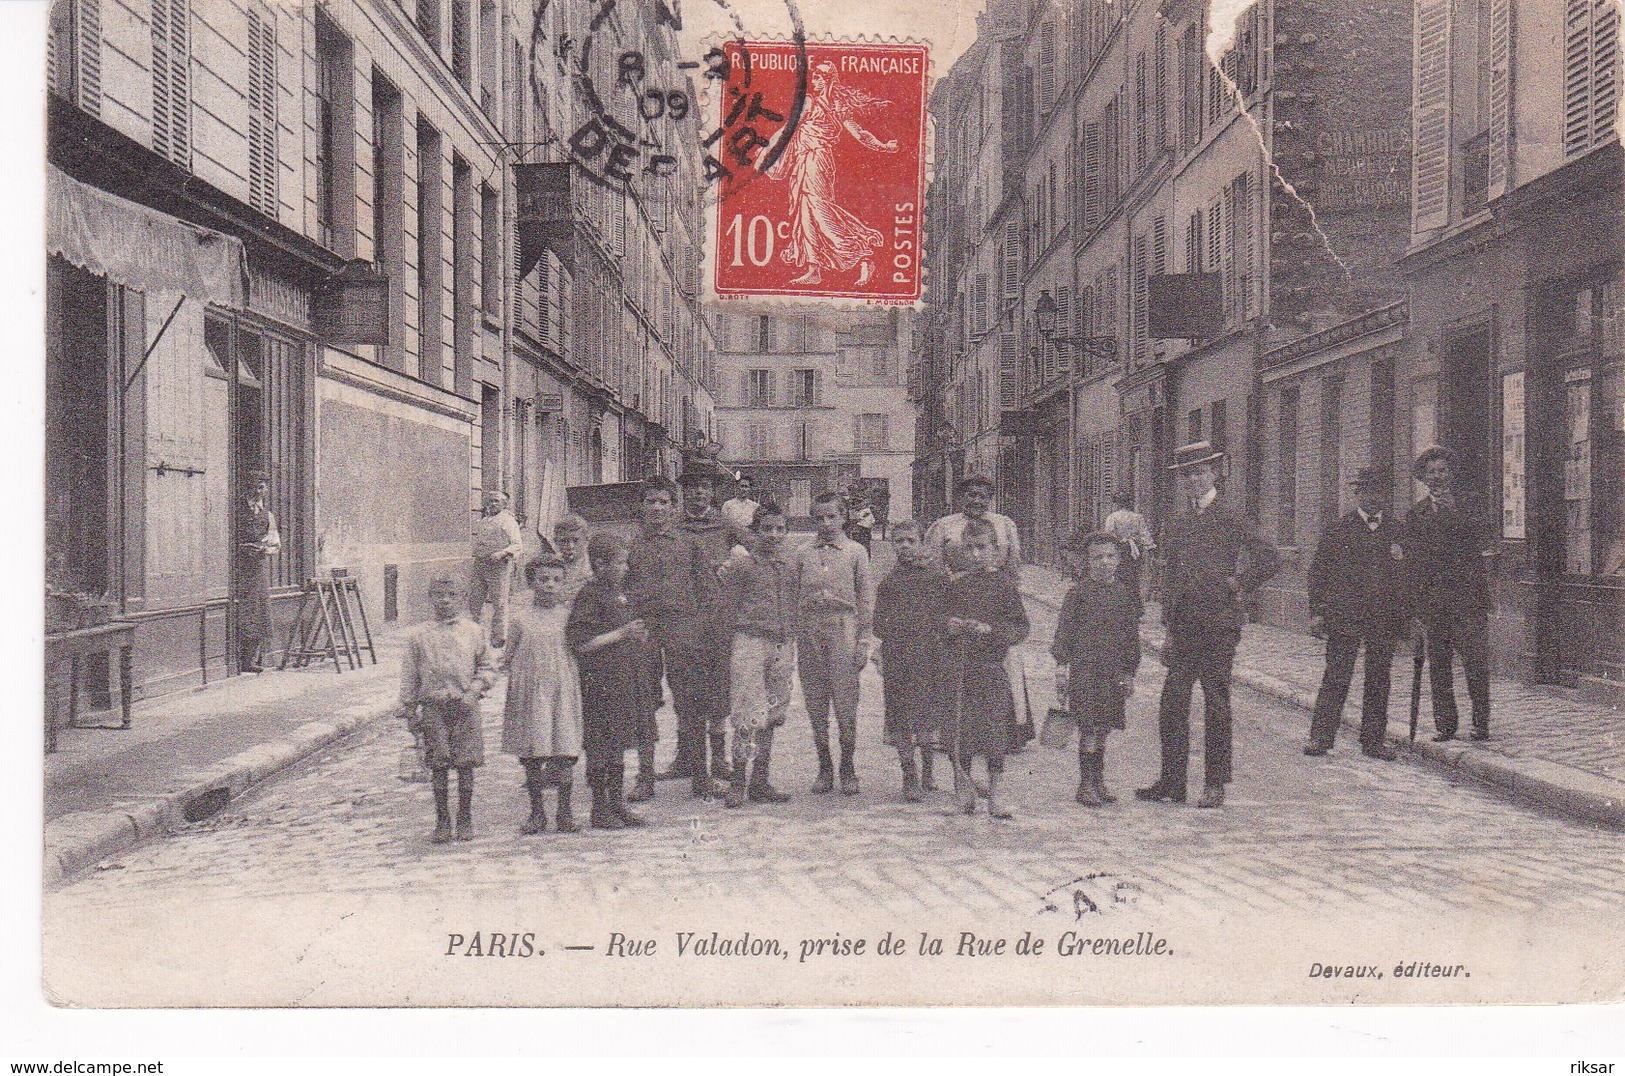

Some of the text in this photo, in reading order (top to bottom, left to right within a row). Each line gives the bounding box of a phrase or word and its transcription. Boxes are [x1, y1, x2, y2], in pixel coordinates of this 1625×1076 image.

[731, 51, 919, 76] RPUBLIQE FRANÇAISE
[892, 202, 914, 283] POSTES
